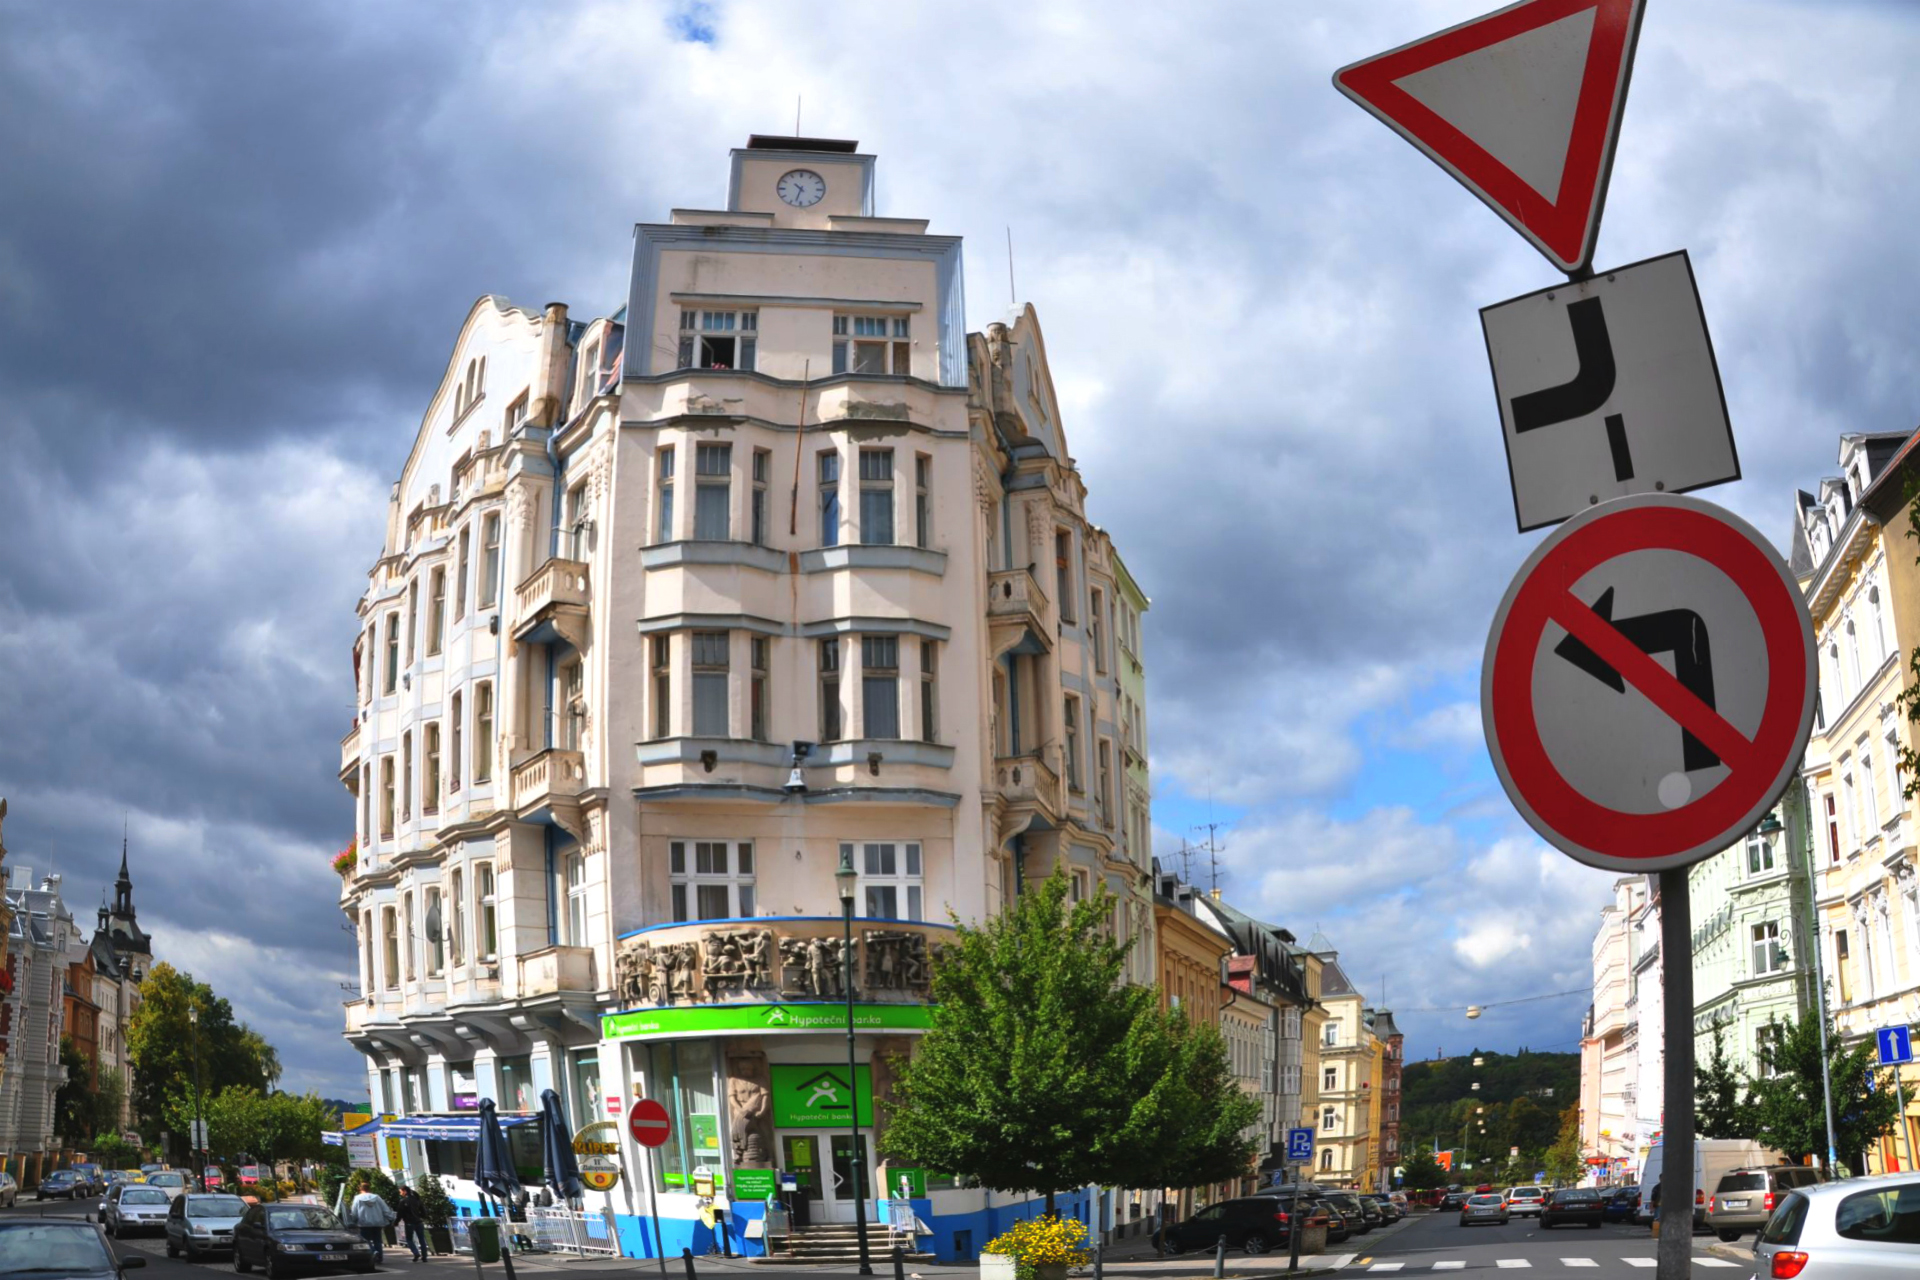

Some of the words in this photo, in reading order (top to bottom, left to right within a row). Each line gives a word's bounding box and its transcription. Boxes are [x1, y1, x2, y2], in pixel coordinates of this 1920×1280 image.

[789, 1015, 845, 1026] Hypoteční
[790, 1113, 829, 1122] Hypoteční
[1293, 1132, 1308, 1150] P
